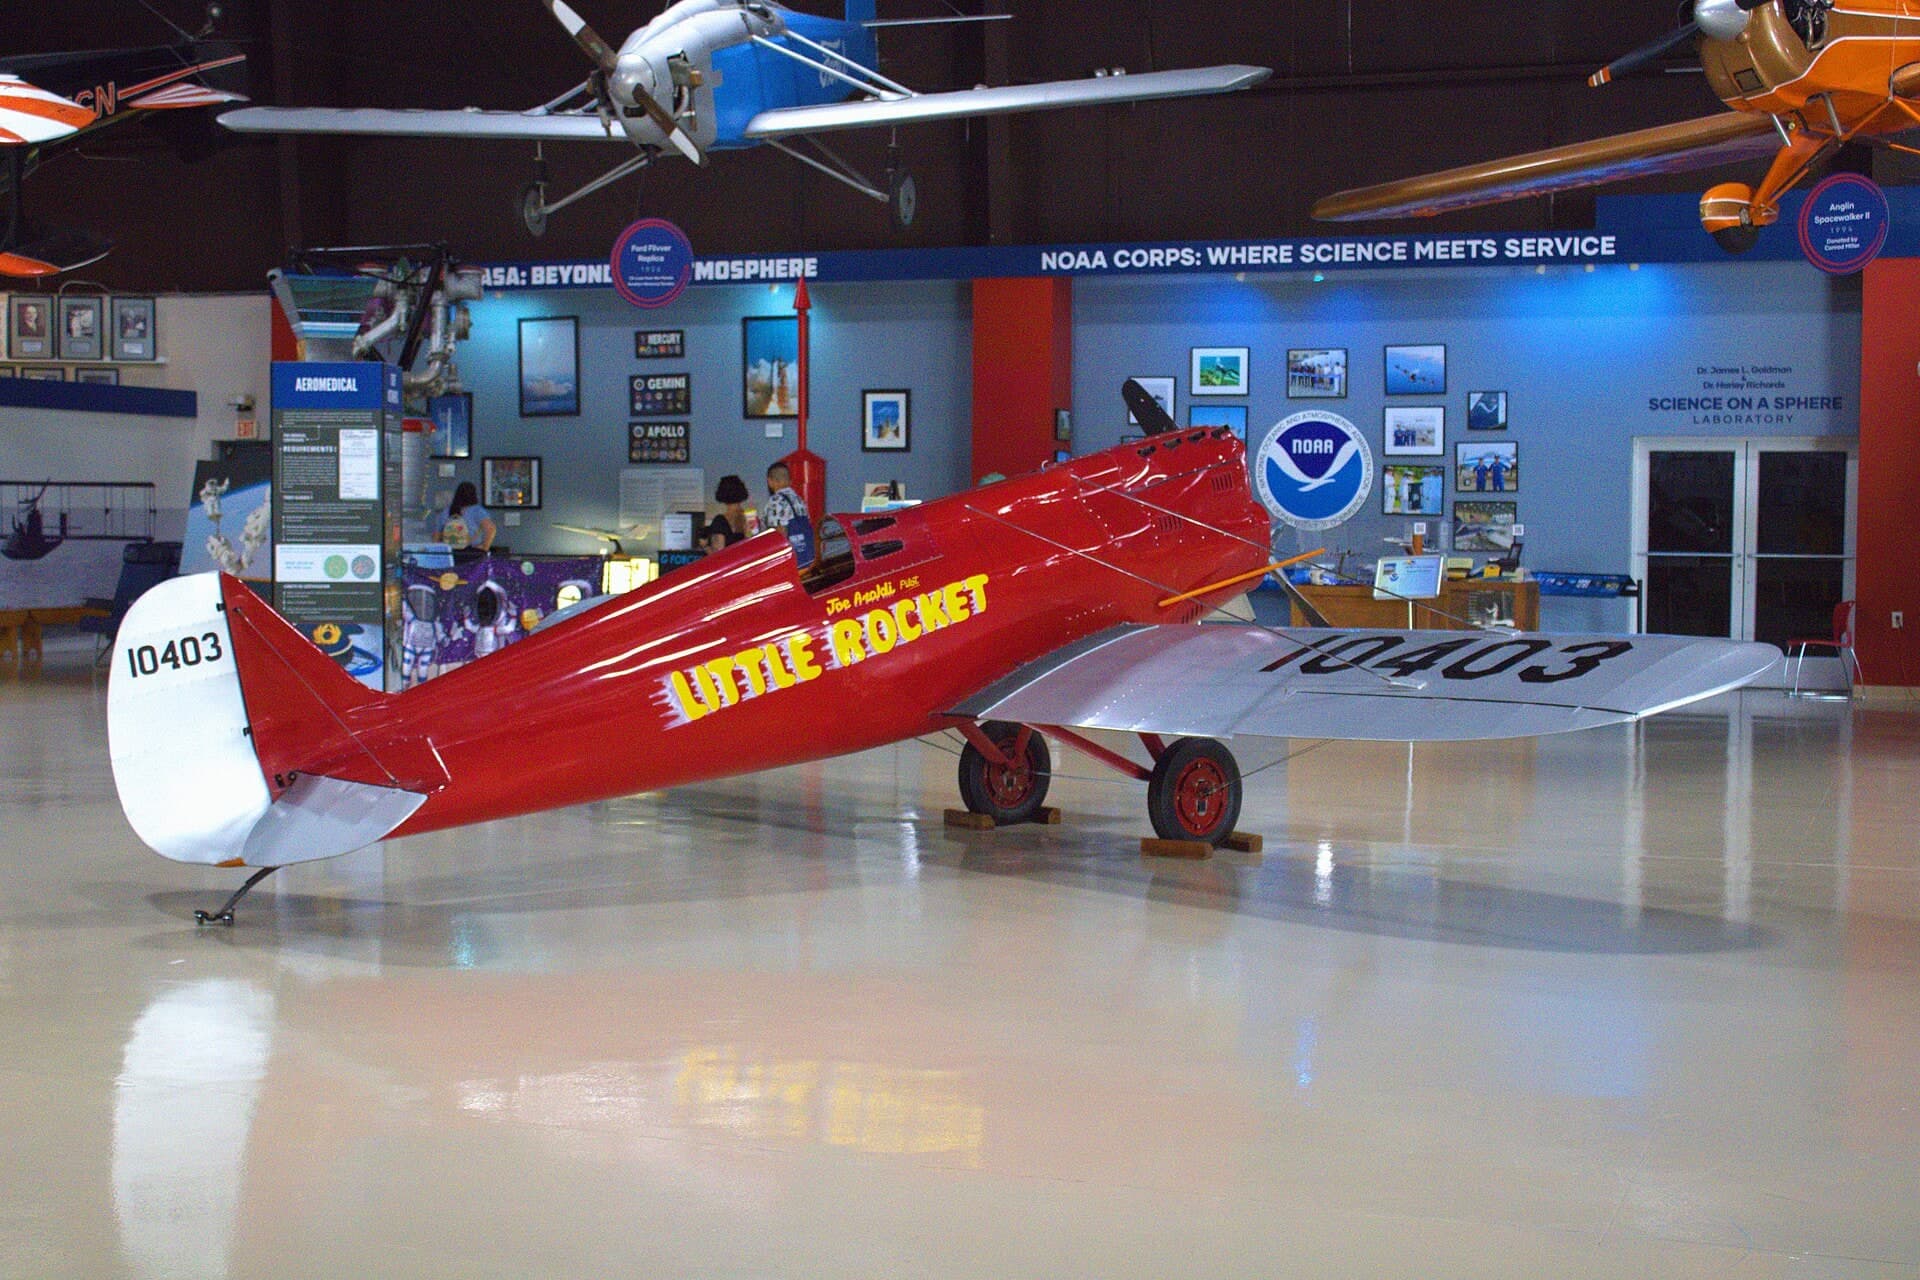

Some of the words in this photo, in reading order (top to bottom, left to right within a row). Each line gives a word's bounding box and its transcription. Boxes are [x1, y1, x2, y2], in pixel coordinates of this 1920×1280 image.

[1829, 201, 1855, 212] Anglin
[1814, 213, 1864, 225] Spacewalker
[1041, 251, 1108, 270] NOAA
[1113, 248, 1201, 268] CORPS:
[1206, 245, 1293, 265] WHERE
[1299, 241, 1407, 263] SCIENCE
[1414, 239, 1498, 260] MEETS
[1504, 235, 1617, 258] SERVICE
[481, 266, 527, 287] ASA:
[692, 257, 818, 281] MOSPHERE
[1710, 367, 1740, 375] James
[295, 377, 358, 392] AEROMEDICAL
[647, 378, 686, 390] GEMINI
[1648, 398, 1724, 411] SCIENCE
[1727, 398, 1753, 411] ON
[1756, 398, 1770, 411] A
[1774, 397, 1843, 410] SPHERE
[1693, 414, 1794, 425] LABORATORY
[647, 425, 685, 438] APOLLO
[1292, 438, 1334, 454] NOAA
[826, 597, 851, 616] Joe
[667, 633, 822, 721] LITTLE
[828, 573, 989, 668] ROCKET
[128, 632, 222, 678] 10403
[1259, 634, 1633, 683] 10403
